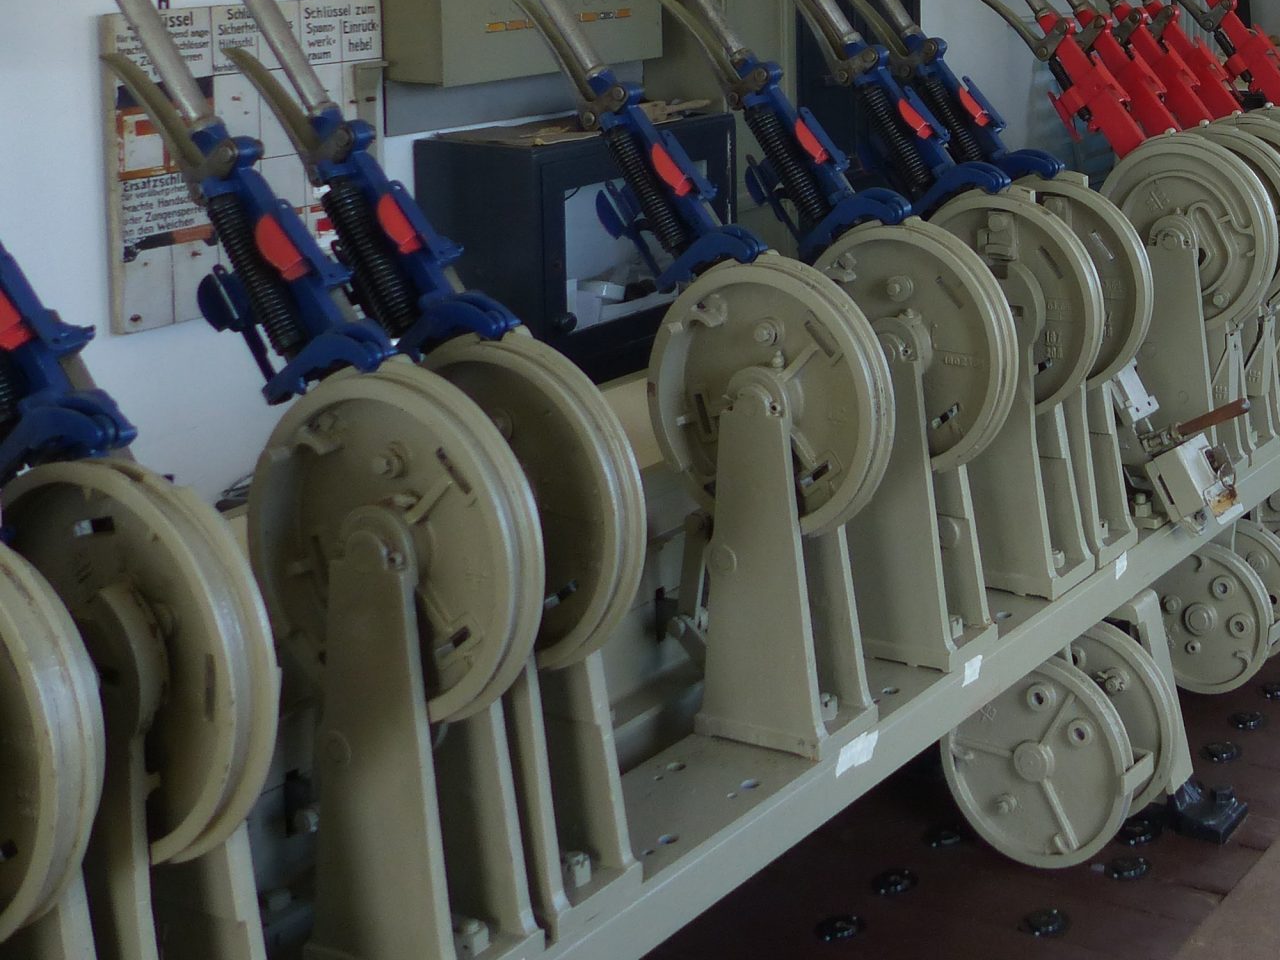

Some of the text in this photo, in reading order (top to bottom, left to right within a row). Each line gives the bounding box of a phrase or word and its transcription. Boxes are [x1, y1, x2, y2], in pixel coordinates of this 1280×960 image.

[304, 4, 376, 19] Schlüssel zum
[348, 36, 372, 52] hebel
